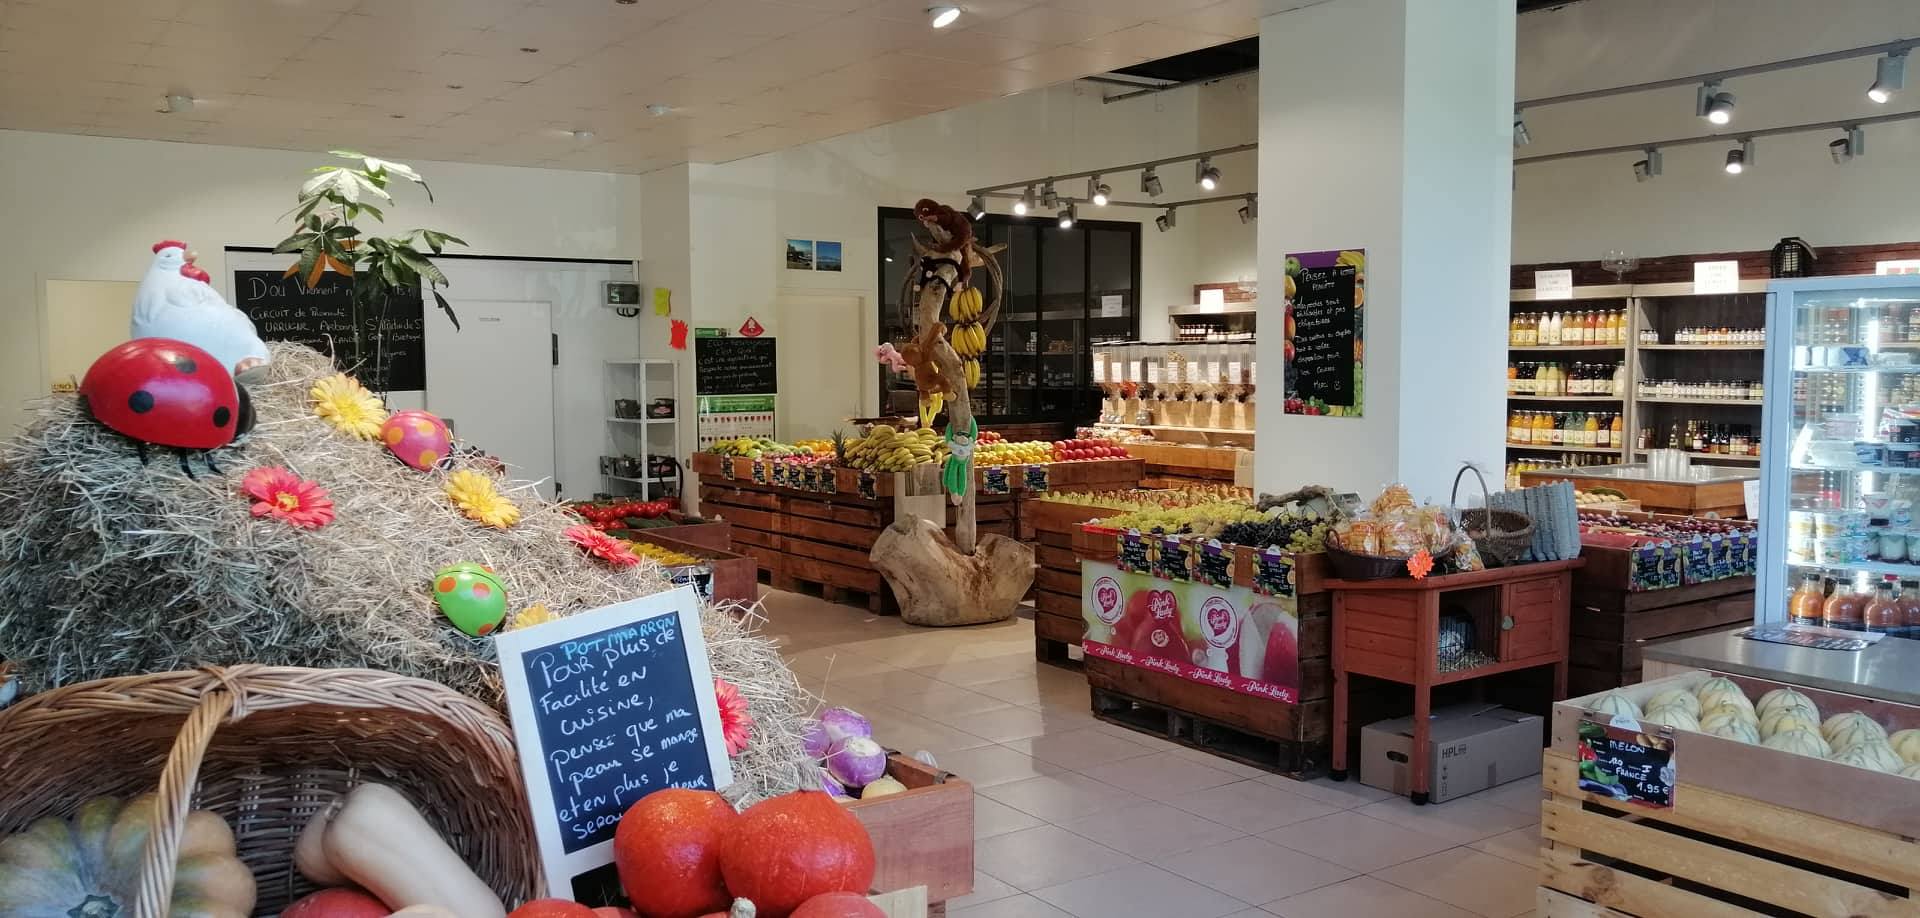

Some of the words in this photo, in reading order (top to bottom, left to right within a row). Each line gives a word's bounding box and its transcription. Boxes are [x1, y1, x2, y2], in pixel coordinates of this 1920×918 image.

[1241, 680, 1269, 693] Pink
[1268, 684, 1293, 703] Lady
[626, 718, 659, 748] que
[665, 707, 694, 724] ma
[660, 727, 699, 751] mange
[1609, 740, 1645, 754] MELON
[1615, 766, 1648, 781] FRANCE
[613, 773, 650, 806] plus
